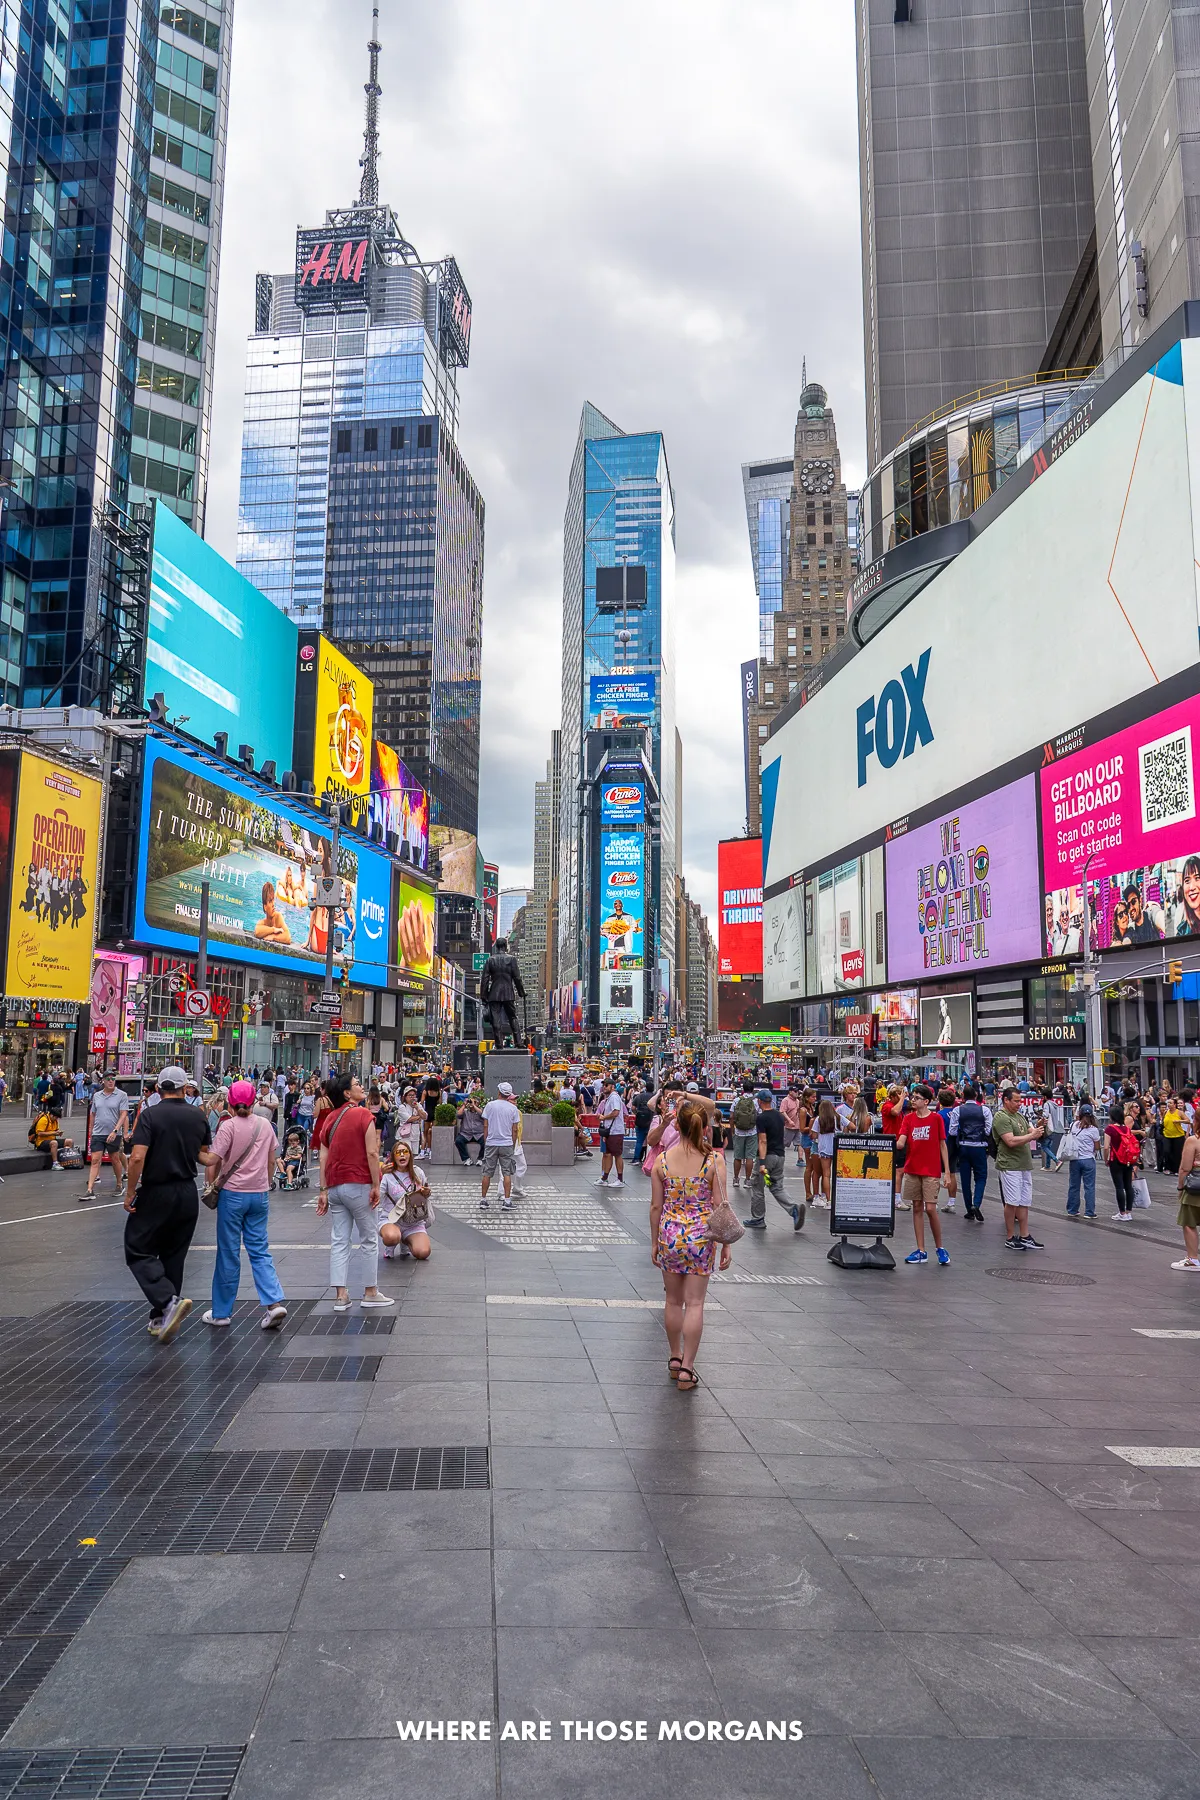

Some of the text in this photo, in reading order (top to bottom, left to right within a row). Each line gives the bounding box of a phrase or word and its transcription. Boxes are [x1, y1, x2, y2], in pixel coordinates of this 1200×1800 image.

[300, 240, 368, 287] H&M
[1051, 399, 1095, 448] MARRIOTT
[1051, 419, 1090, 463] MARQUIS
[854, 558, 886, 591] MARRIOTT
[854, 574, 881, 603] MARQUIS
[300, 663, 313, 672] LG
[611, 666, 634, 675] 2025
[857, 646, 934, 788] FOX
[1056, 726, 1086, 746] MARRIOTT
[1056, 737, 1083, 756] MARQUIS
[1051, 755, 1124, 802] GET ON OUR
[1055, 781, 1121, 824] BILLBOARD
[156, 810, 223, 851] I TURNED
[187, 792, 266, 843] THE SUMMER
[893, 817, 909, 828] MARRIOTT
[893, 826, 908, 836] MARQUIS
[1057, 812, 1122, 846] Scan QR code
[34, 813, 86, 855] OPERATION
[940, 817, 961, 856] WE
[1058, 829, 1122, 863] to get started
[202, 858, 249, 888] PRETTY
[213, 892, 225, 901] Have
[226, 896, 244, 906] Summer
[361, 896, 385, 923] prime
[724, 888, 763, 905] DRIVING
[175, 904, 191, 918] FINAL
[216, 913, 233, 927] WATCH
[233, 918, 244, 930] NOW
[50, 963, 70, 971] MUSICAL
[1042, 964, 1067, 974] SEPHORA
[38, 1000, 80, 1015] LUGGAGE
[1029, 1026, 1076, 1041] SEPHORA
[839, 1138, 867, 1146] MIDNIGHT
